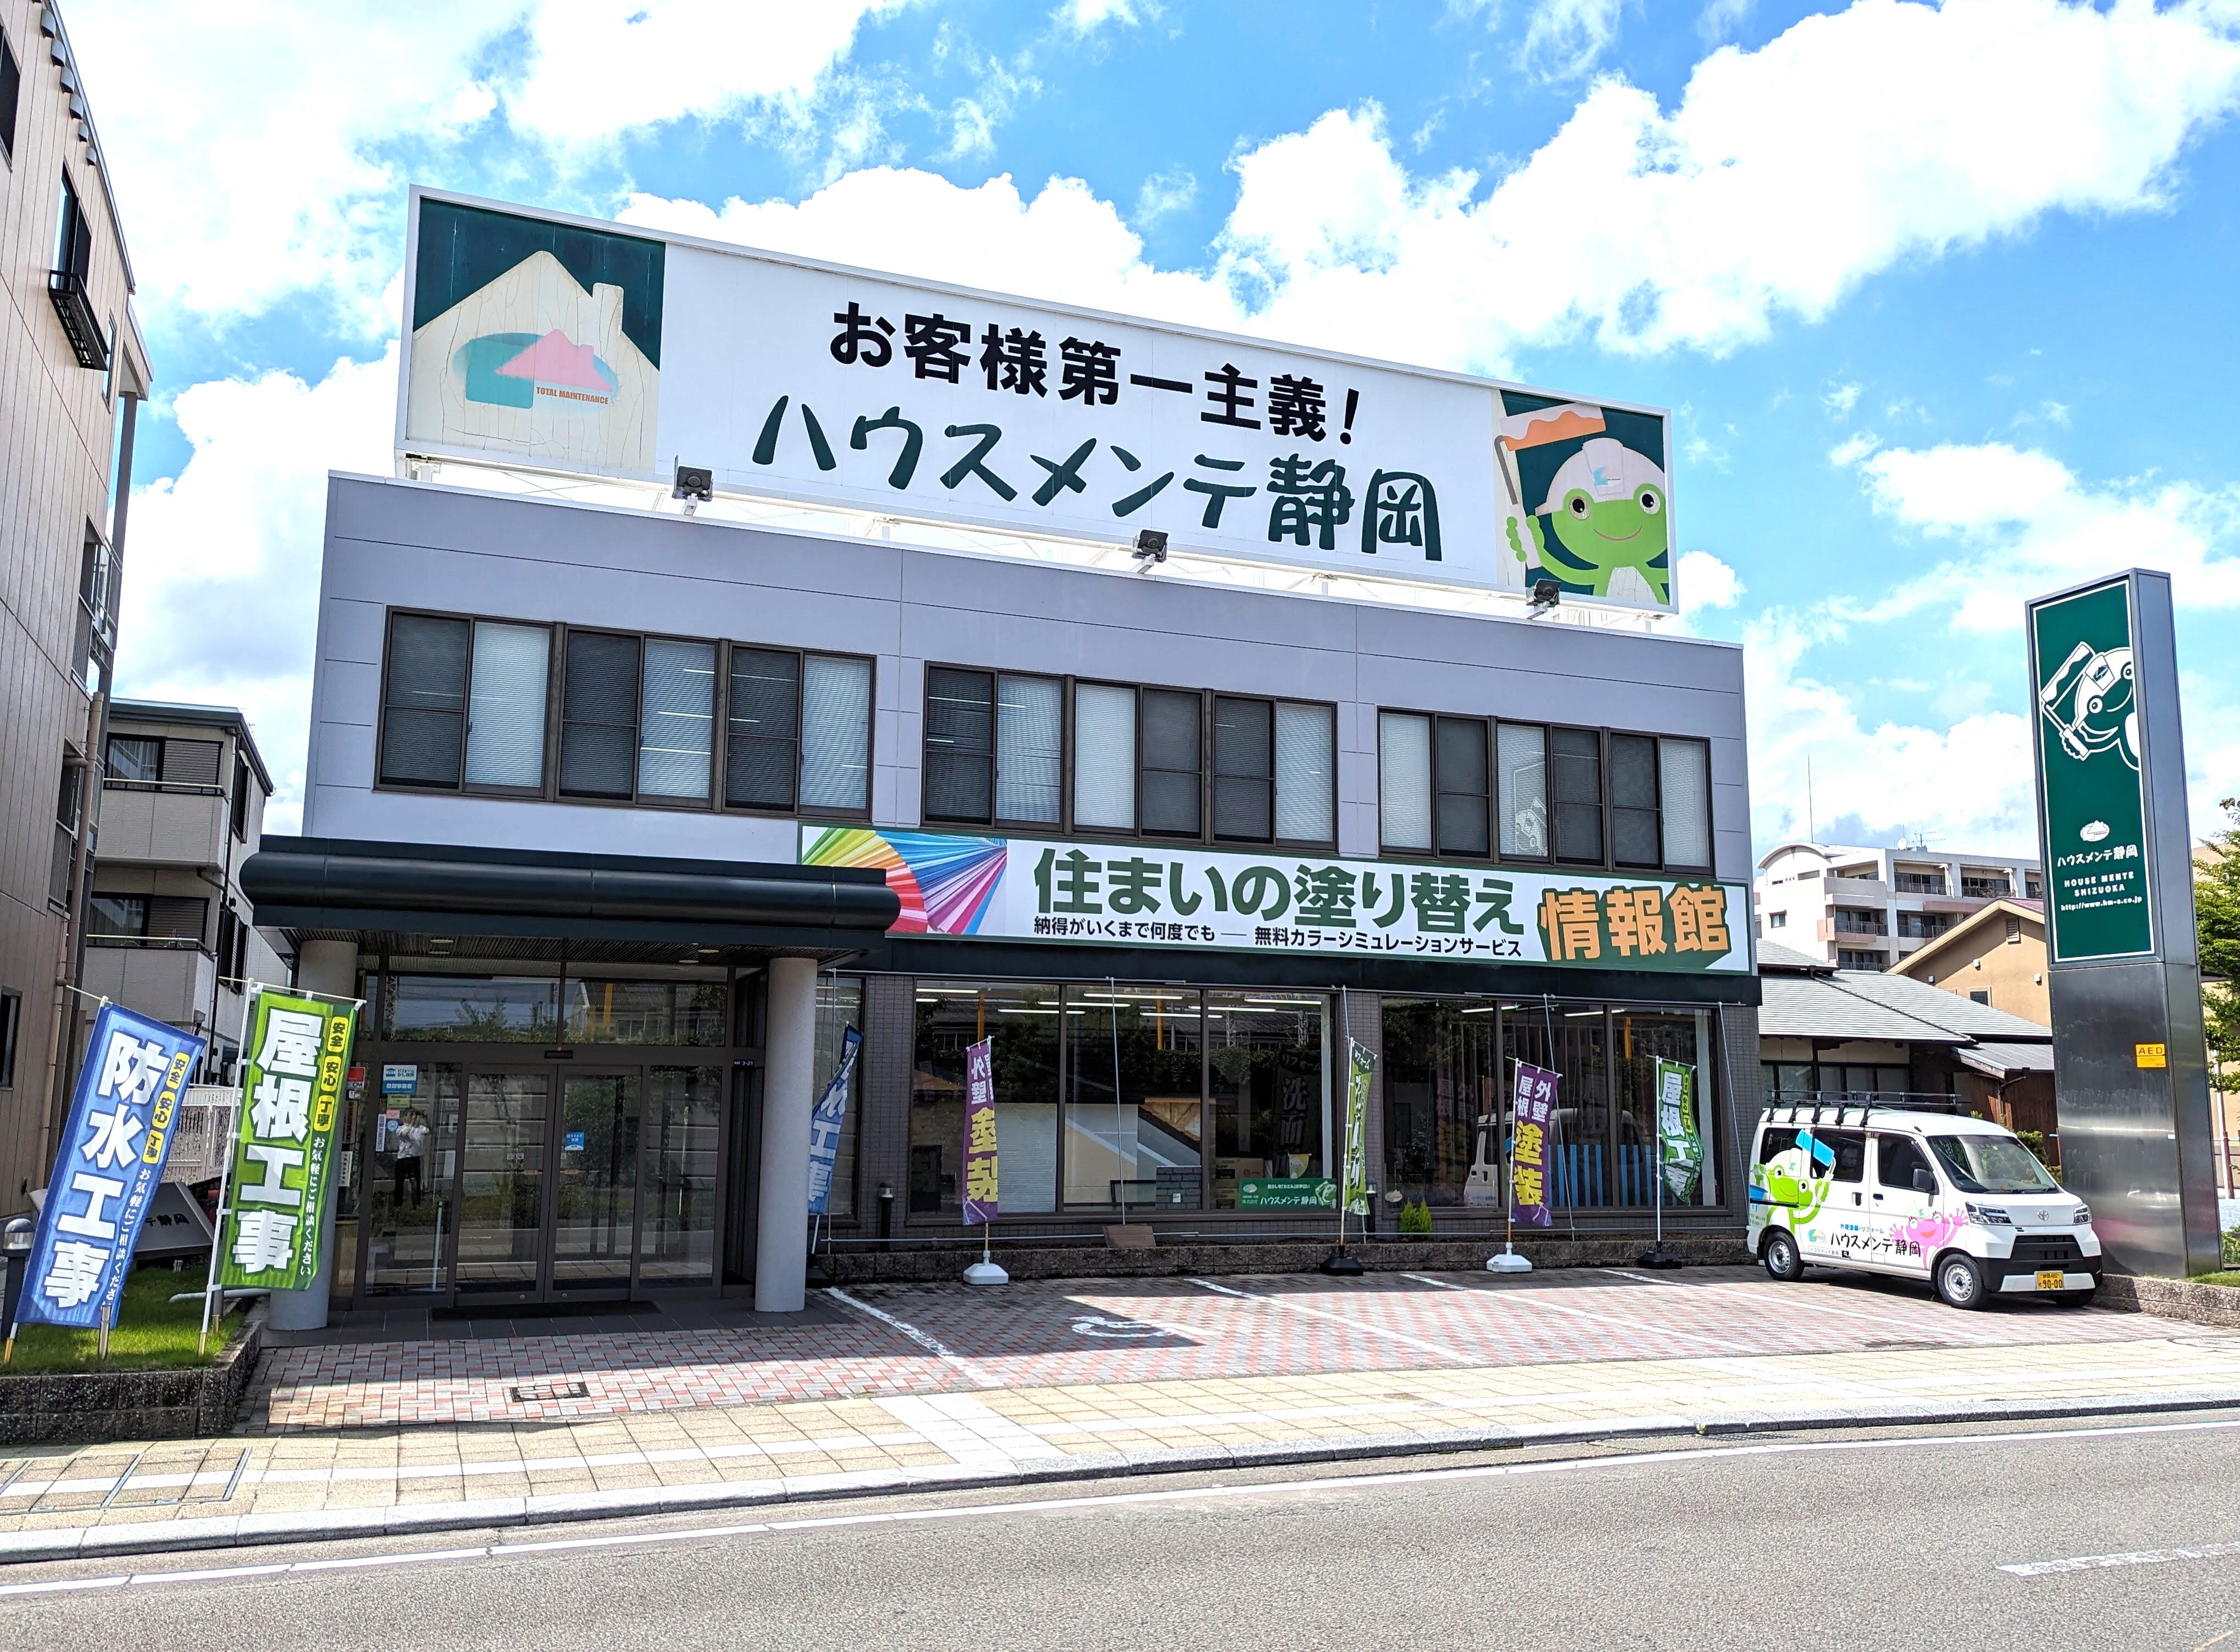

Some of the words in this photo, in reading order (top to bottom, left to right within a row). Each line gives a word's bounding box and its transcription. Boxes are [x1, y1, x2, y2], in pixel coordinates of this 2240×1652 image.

[536, 387, 557, 396] TOTAL
[559, 390, 608, 405] MAINTENANCE
[752, 395, 1442, 563] ハウスメンテ静岡
[2057, 844, 2138, 867] ハウスメンテ静岡
[1034, 847, 1524, 936] 住まいの塗り替え
[2064, 876, 2097, 888] HOUSE
[2101, 871, 2135, 883] MENTE
[2074, 883, 2125, 897] SHIZUOKA
[2060, 895, 2142, 911] http://www.hm-s.co.jp
[1540, 886, 1728, 961] 情報館
[330, 1021, 345, 1049] 安全
[323, 1061, 338, 1086] 安心
[1517, 1075, 1534, 1118] 屋根
[1531, 1080, 1552, 1123] 外壁
[233, 1008, 324, 1274] 屋根工事
[44, 1031, 171, 1309] 防水工事
[1513, 1119, 1544, 1206] 塗装
[1260, 1196, 1317, 1205] ハウスメンテ静岡
[1831, 1233, 1921, 1257] ハウスメンテ静岡
[2042, 1279, 2063, 1289] 90-00
